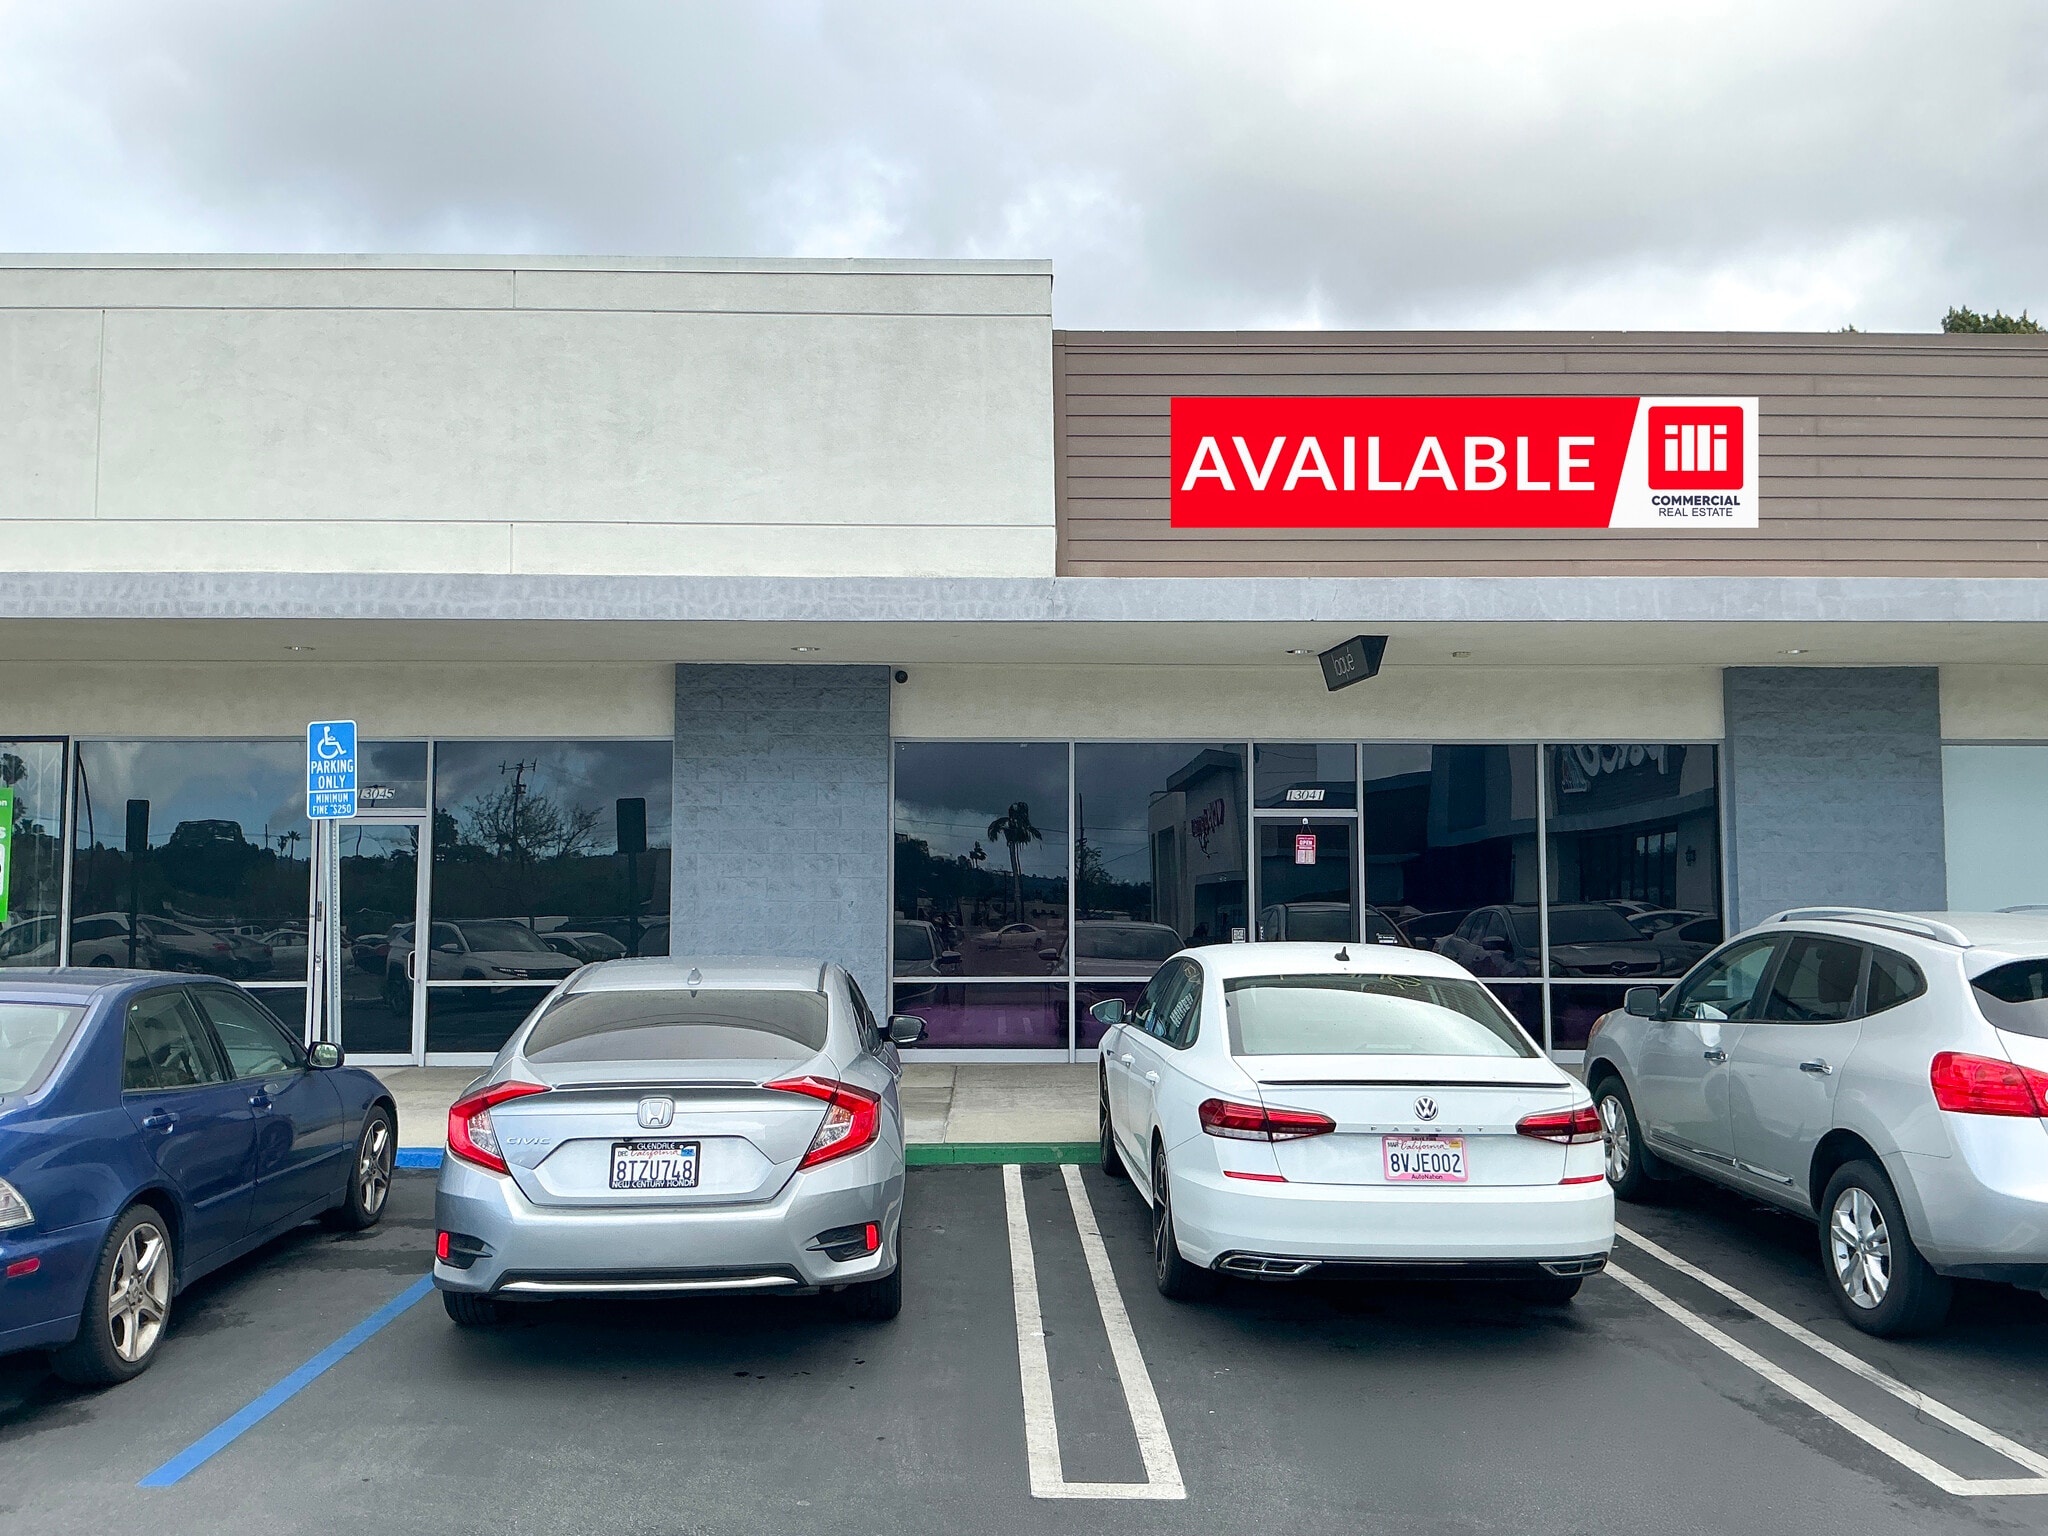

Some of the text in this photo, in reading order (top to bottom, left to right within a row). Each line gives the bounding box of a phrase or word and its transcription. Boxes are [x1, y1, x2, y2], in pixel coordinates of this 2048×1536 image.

[1181, 435, 1596, 491] AVAILABLE
[1651, 495, 1740, 507] COMMERCIAL
[1658, 507, 1733, 517] REAL ESTATE
[311, 759, 353, 774] PARKING
[318, 775, 346, 789] ONLY
[316, 793, 348, 803] MINIMUM
[1288, 790, 1323, 800] 13041
[312, 805, 328, 814] FINE
[507, 1137, 551, 1145] CIVIC
[1400, 1140, 1450, 1152] California
[1390, 1153, 1462, 1173] 8VJE002
[616, 1159, 693, 1181] 8TZU748
[612, 1179, 695, 1188] NEW CENTURY HONDA
